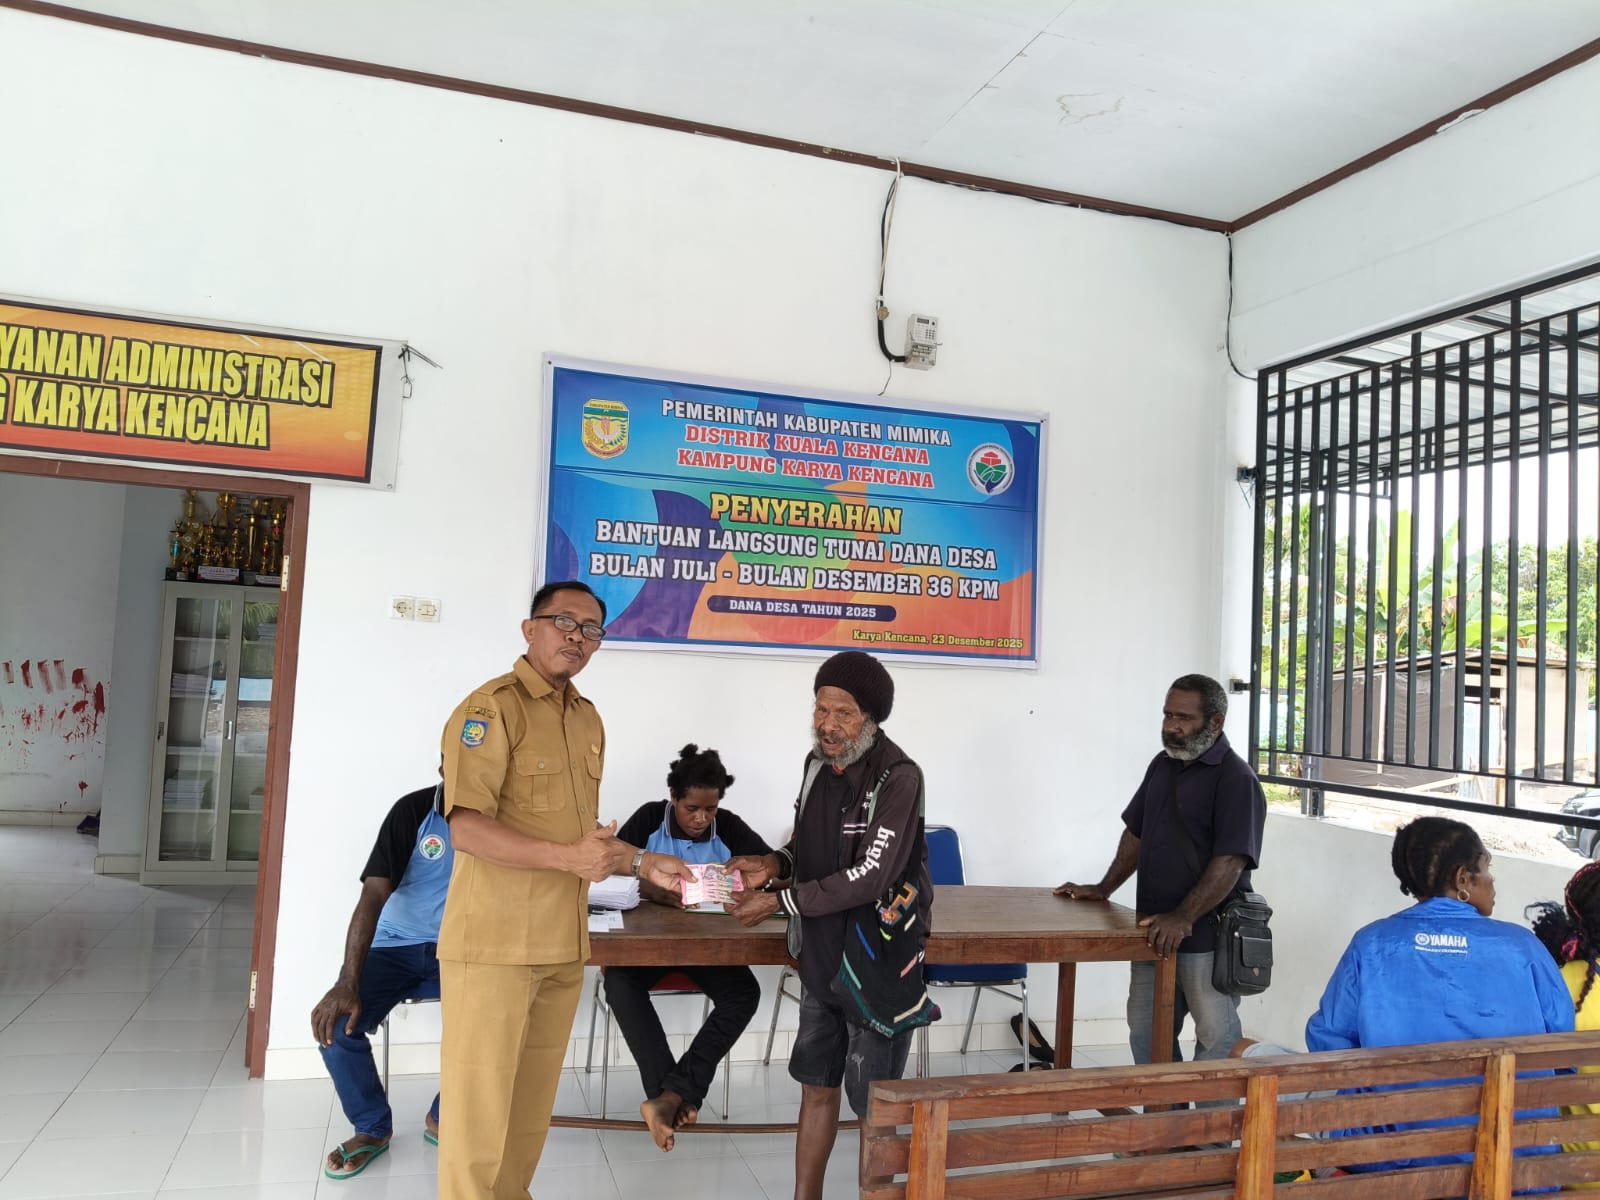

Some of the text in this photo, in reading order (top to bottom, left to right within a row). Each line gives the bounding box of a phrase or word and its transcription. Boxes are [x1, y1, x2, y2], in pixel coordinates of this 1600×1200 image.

[104, 336, 335, 408] ADMINISTRASI
[12, 376, 120, 435] KARYA
[124, 389, 270, 450] KENCANA
[661, 399, 952, 447] PEMERINTAH KABUPATEN MIMIKA
[685, 424, 930, 466] DISTRIK KUALA KENCANA
[677, 448, 935, 489] KAMPUNG KARYA KENCANA
[710, 492, 902, 534] PENYERAHAN
[596, 519, 998, 571] BANTUAN LANGSUNG TUNAI DANA DESA
[589, 552, 666, 579] BULAN
[671, 558, 718, 583] JULI
[738, 562, 807, 589] BULAN
[812, 567, 923, 596] DESEMBER
[927, 574, 953, 598] 36
[958, 577, 1000, 601] KPM
[729, 599, 877, 618] DANA DESA TAHUN 2025
[852, 629, 882, 644] Karya
[932, 633, 945, 645] 23
[947, 634, 995, 647] Desember
[997, 636, 1024, 649] 2025
[1430, 934, 1468, 947] YAMAHA
